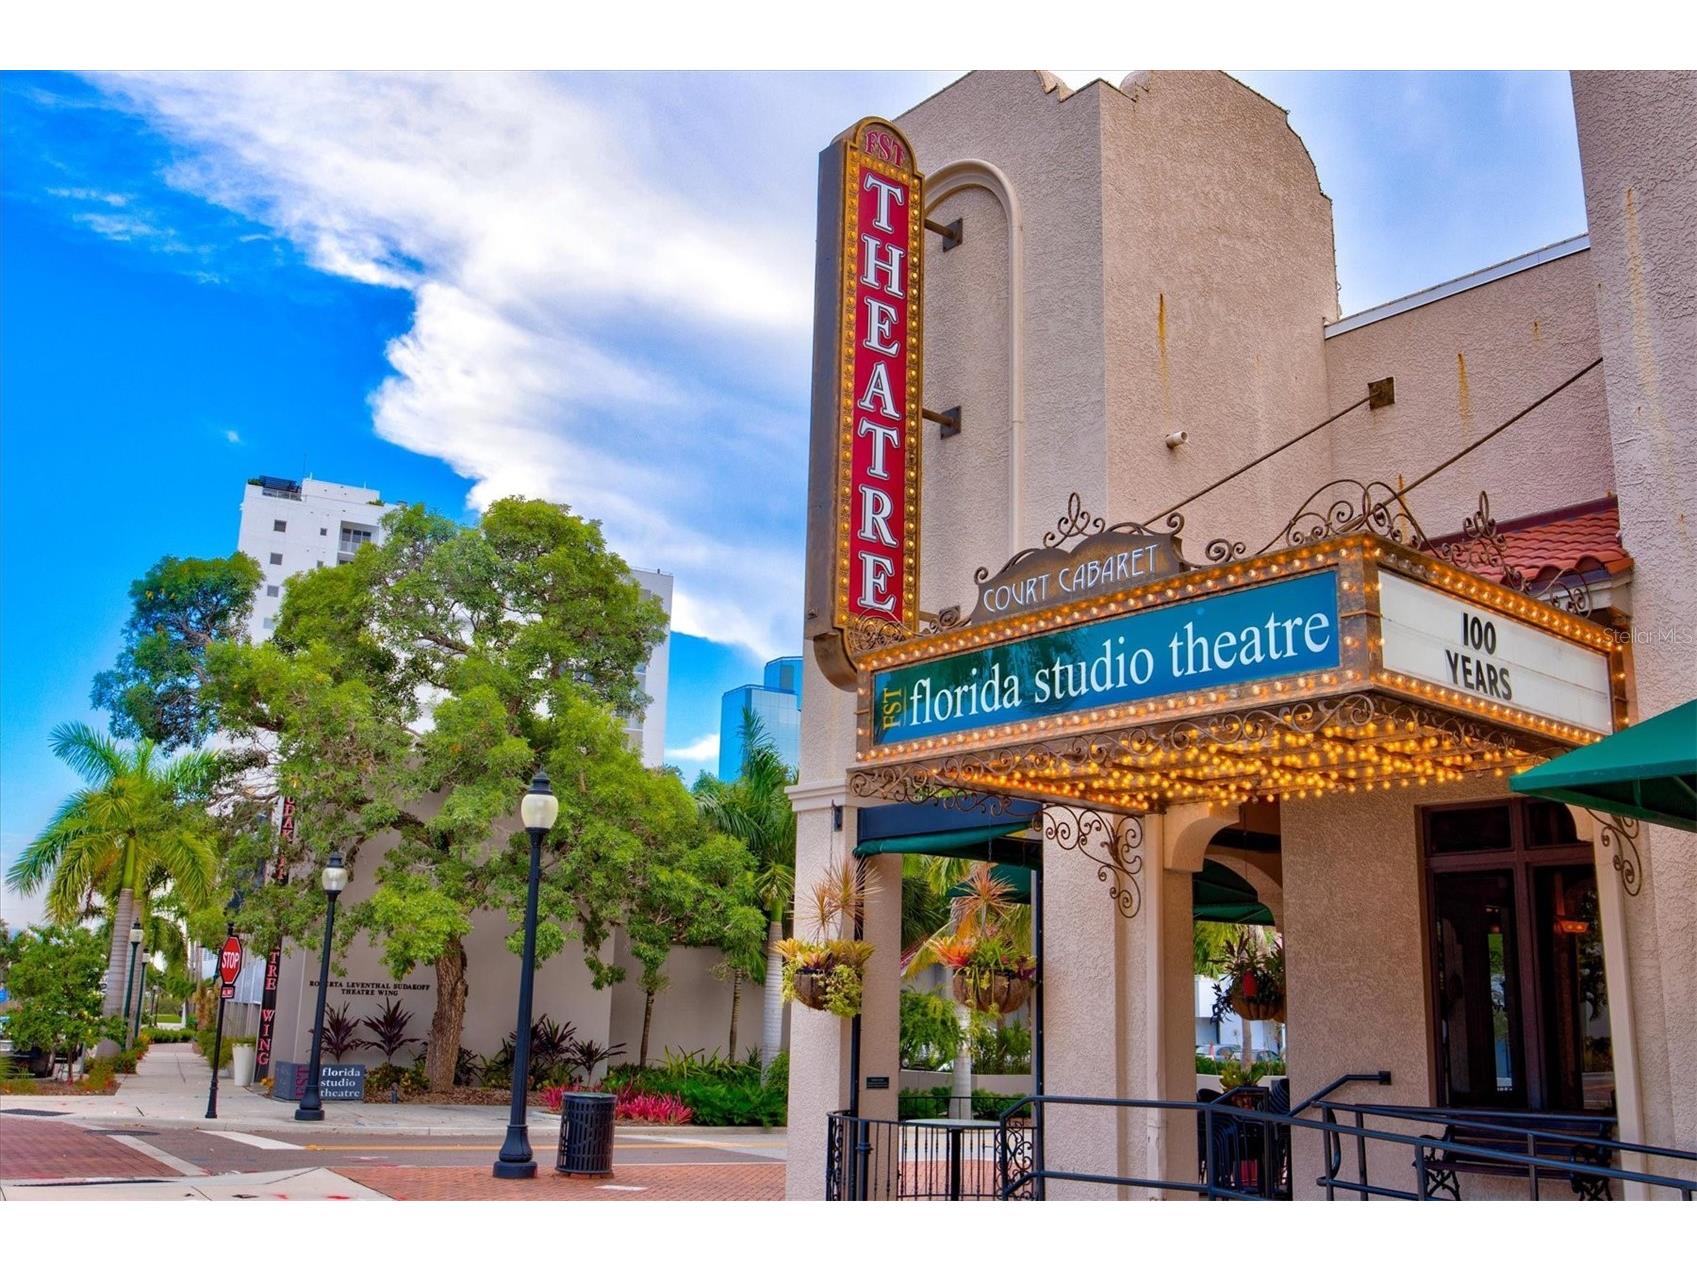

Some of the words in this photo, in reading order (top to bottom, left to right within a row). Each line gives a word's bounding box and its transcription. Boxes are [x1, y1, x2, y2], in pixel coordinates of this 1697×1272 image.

[864, 129, 905, 168] FST
[858, 171, 905, 614] THEATRE
[983, 573, 1051, 613] COURT
[1058, 543, 1158, 593] CABARET
[1462, 611, 1497, 656] 100
[909, 664, 1022, 726] florida
[1033, 636, 1155, 704] studio
[1168, 612, 1331, 679] theatre
[1445, 649, 1513, 701] YEARS
[882, 687, 902, 730] FST
[221, 951, 240, 969] STOP
[309, 980, 343, 988] RORTA
[256, 1009, 275, 1065] WING
[320, 1078, 356, 1087] studio
[320, 1088, 360, 1097] theatre
[321, 1066, 361, 1077] florida
